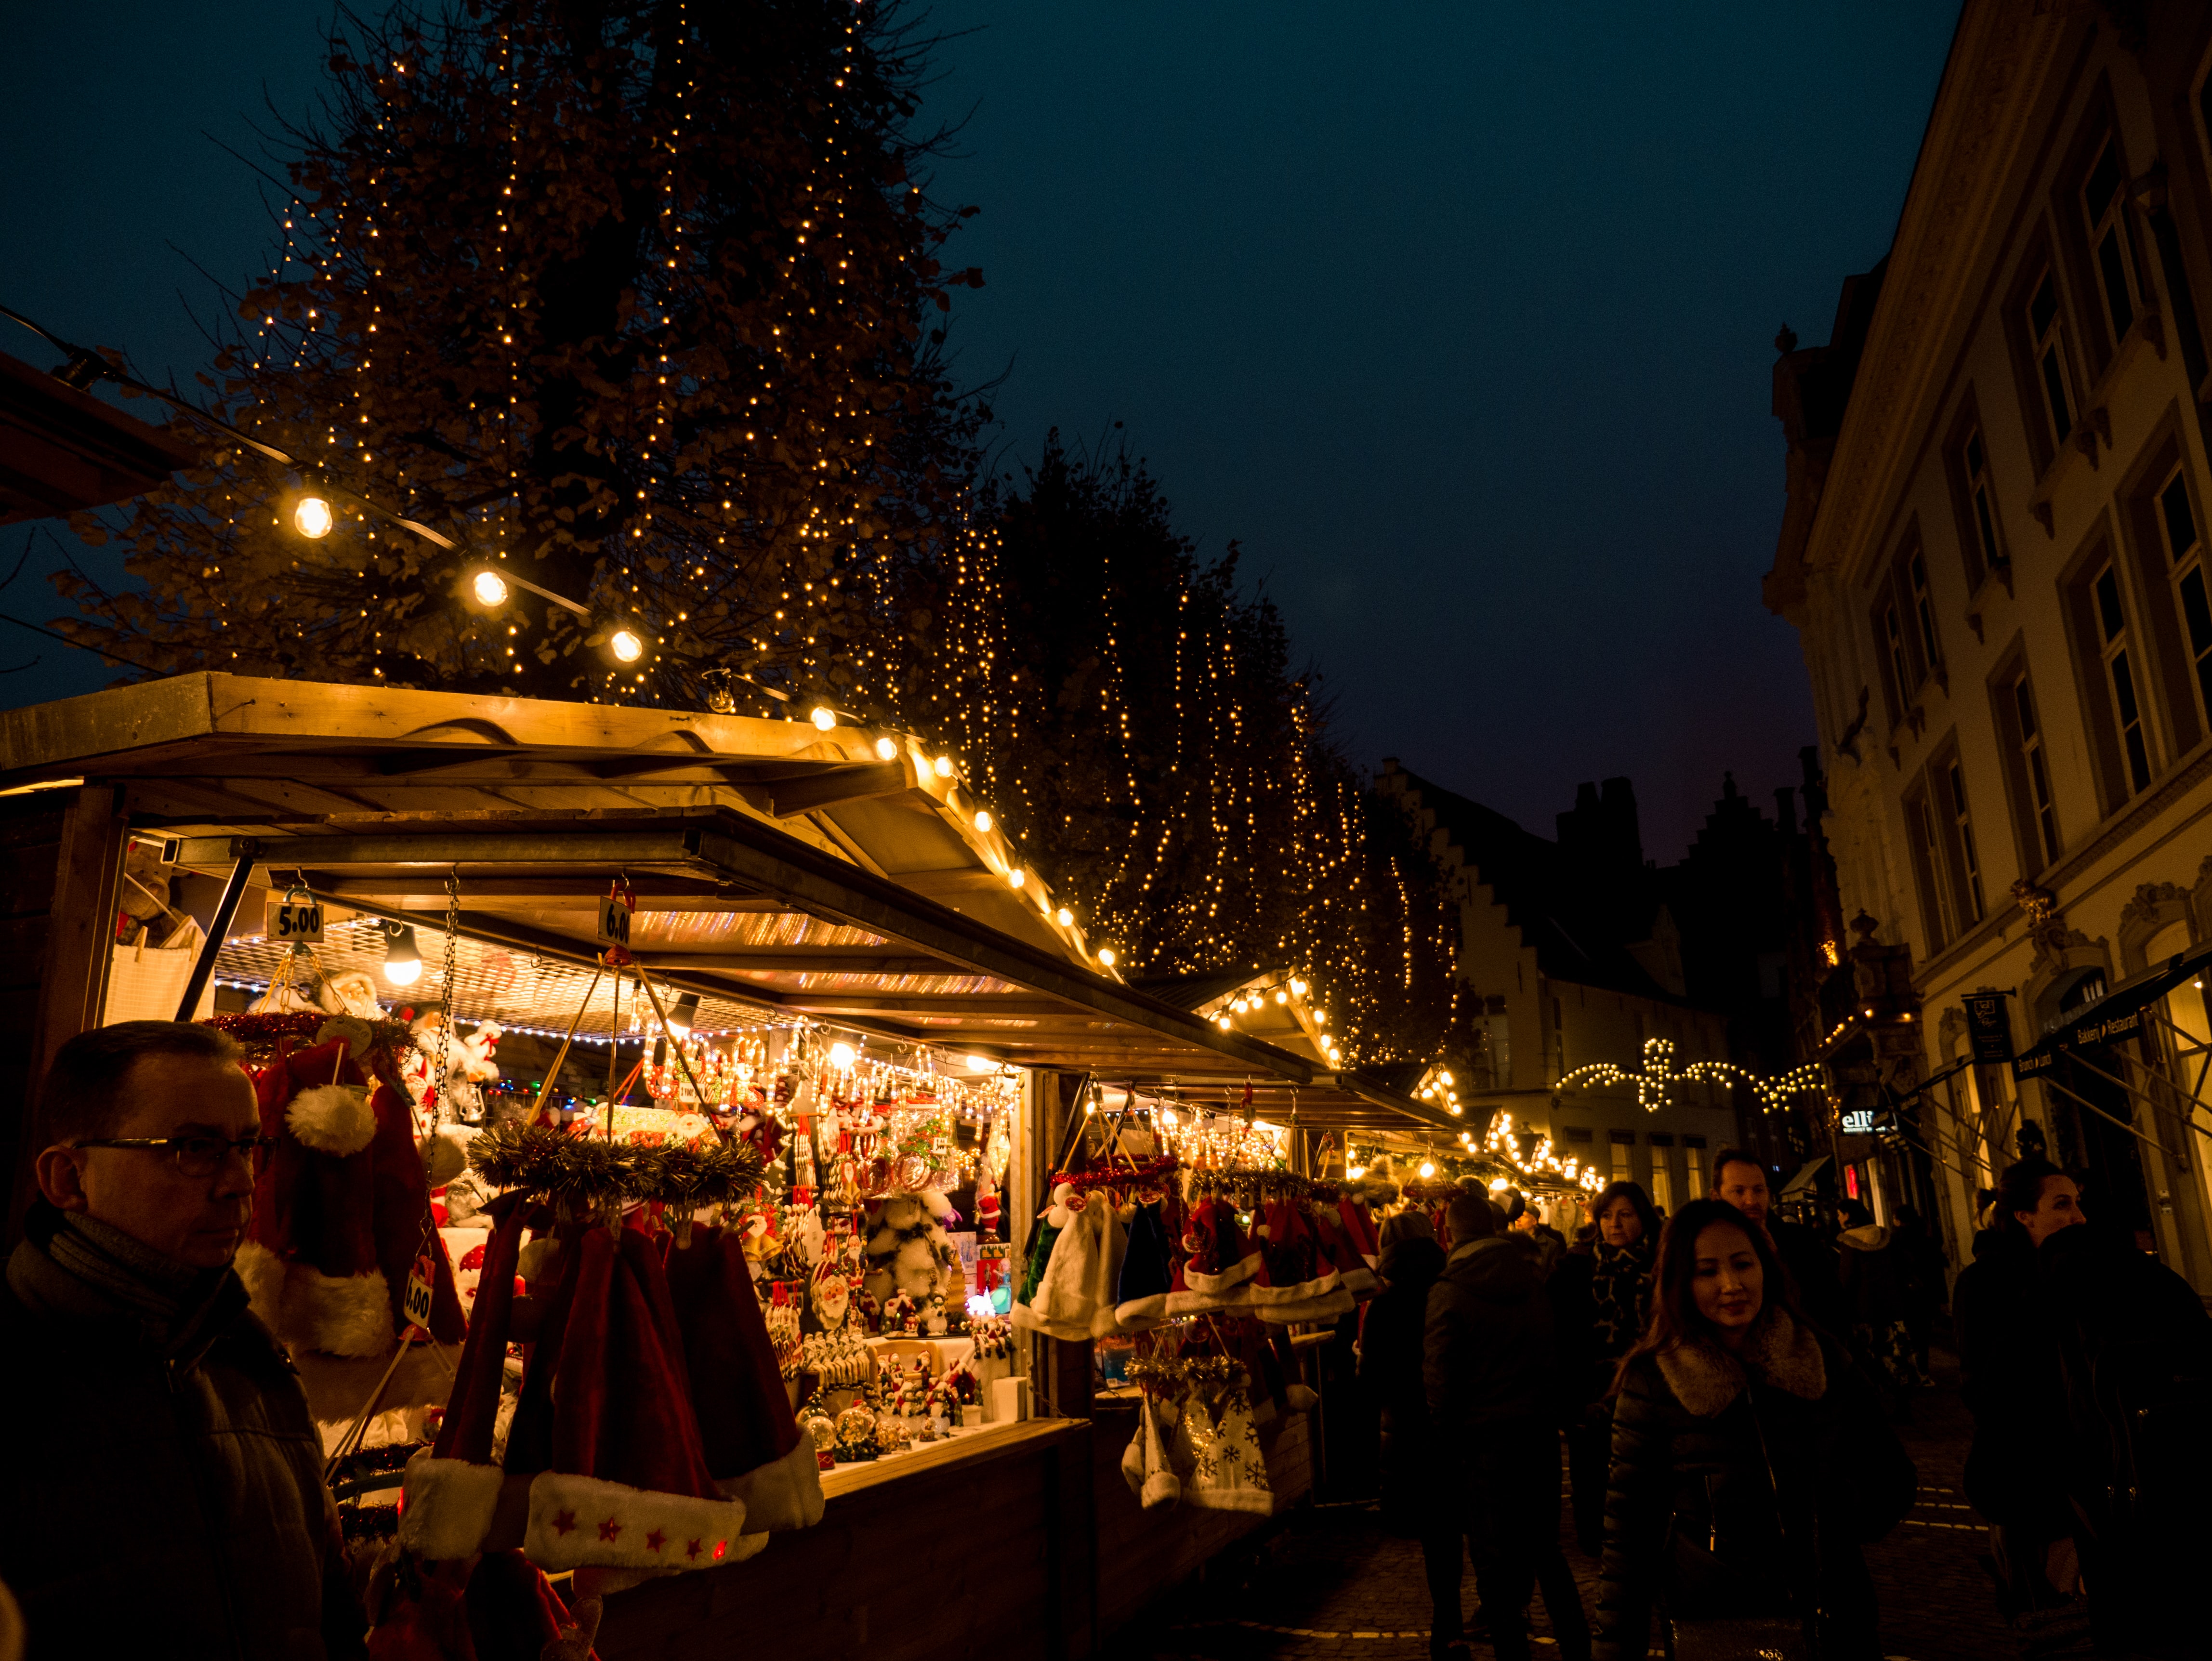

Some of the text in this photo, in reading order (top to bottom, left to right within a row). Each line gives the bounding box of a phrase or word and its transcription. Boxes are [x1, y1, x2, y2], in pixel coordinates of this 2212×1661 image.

[279, 906, 319, 936] 5.00
[2106, 1011, 2139, 1036] Restaurant
[406, 1277, 429, 1318] 6.00
